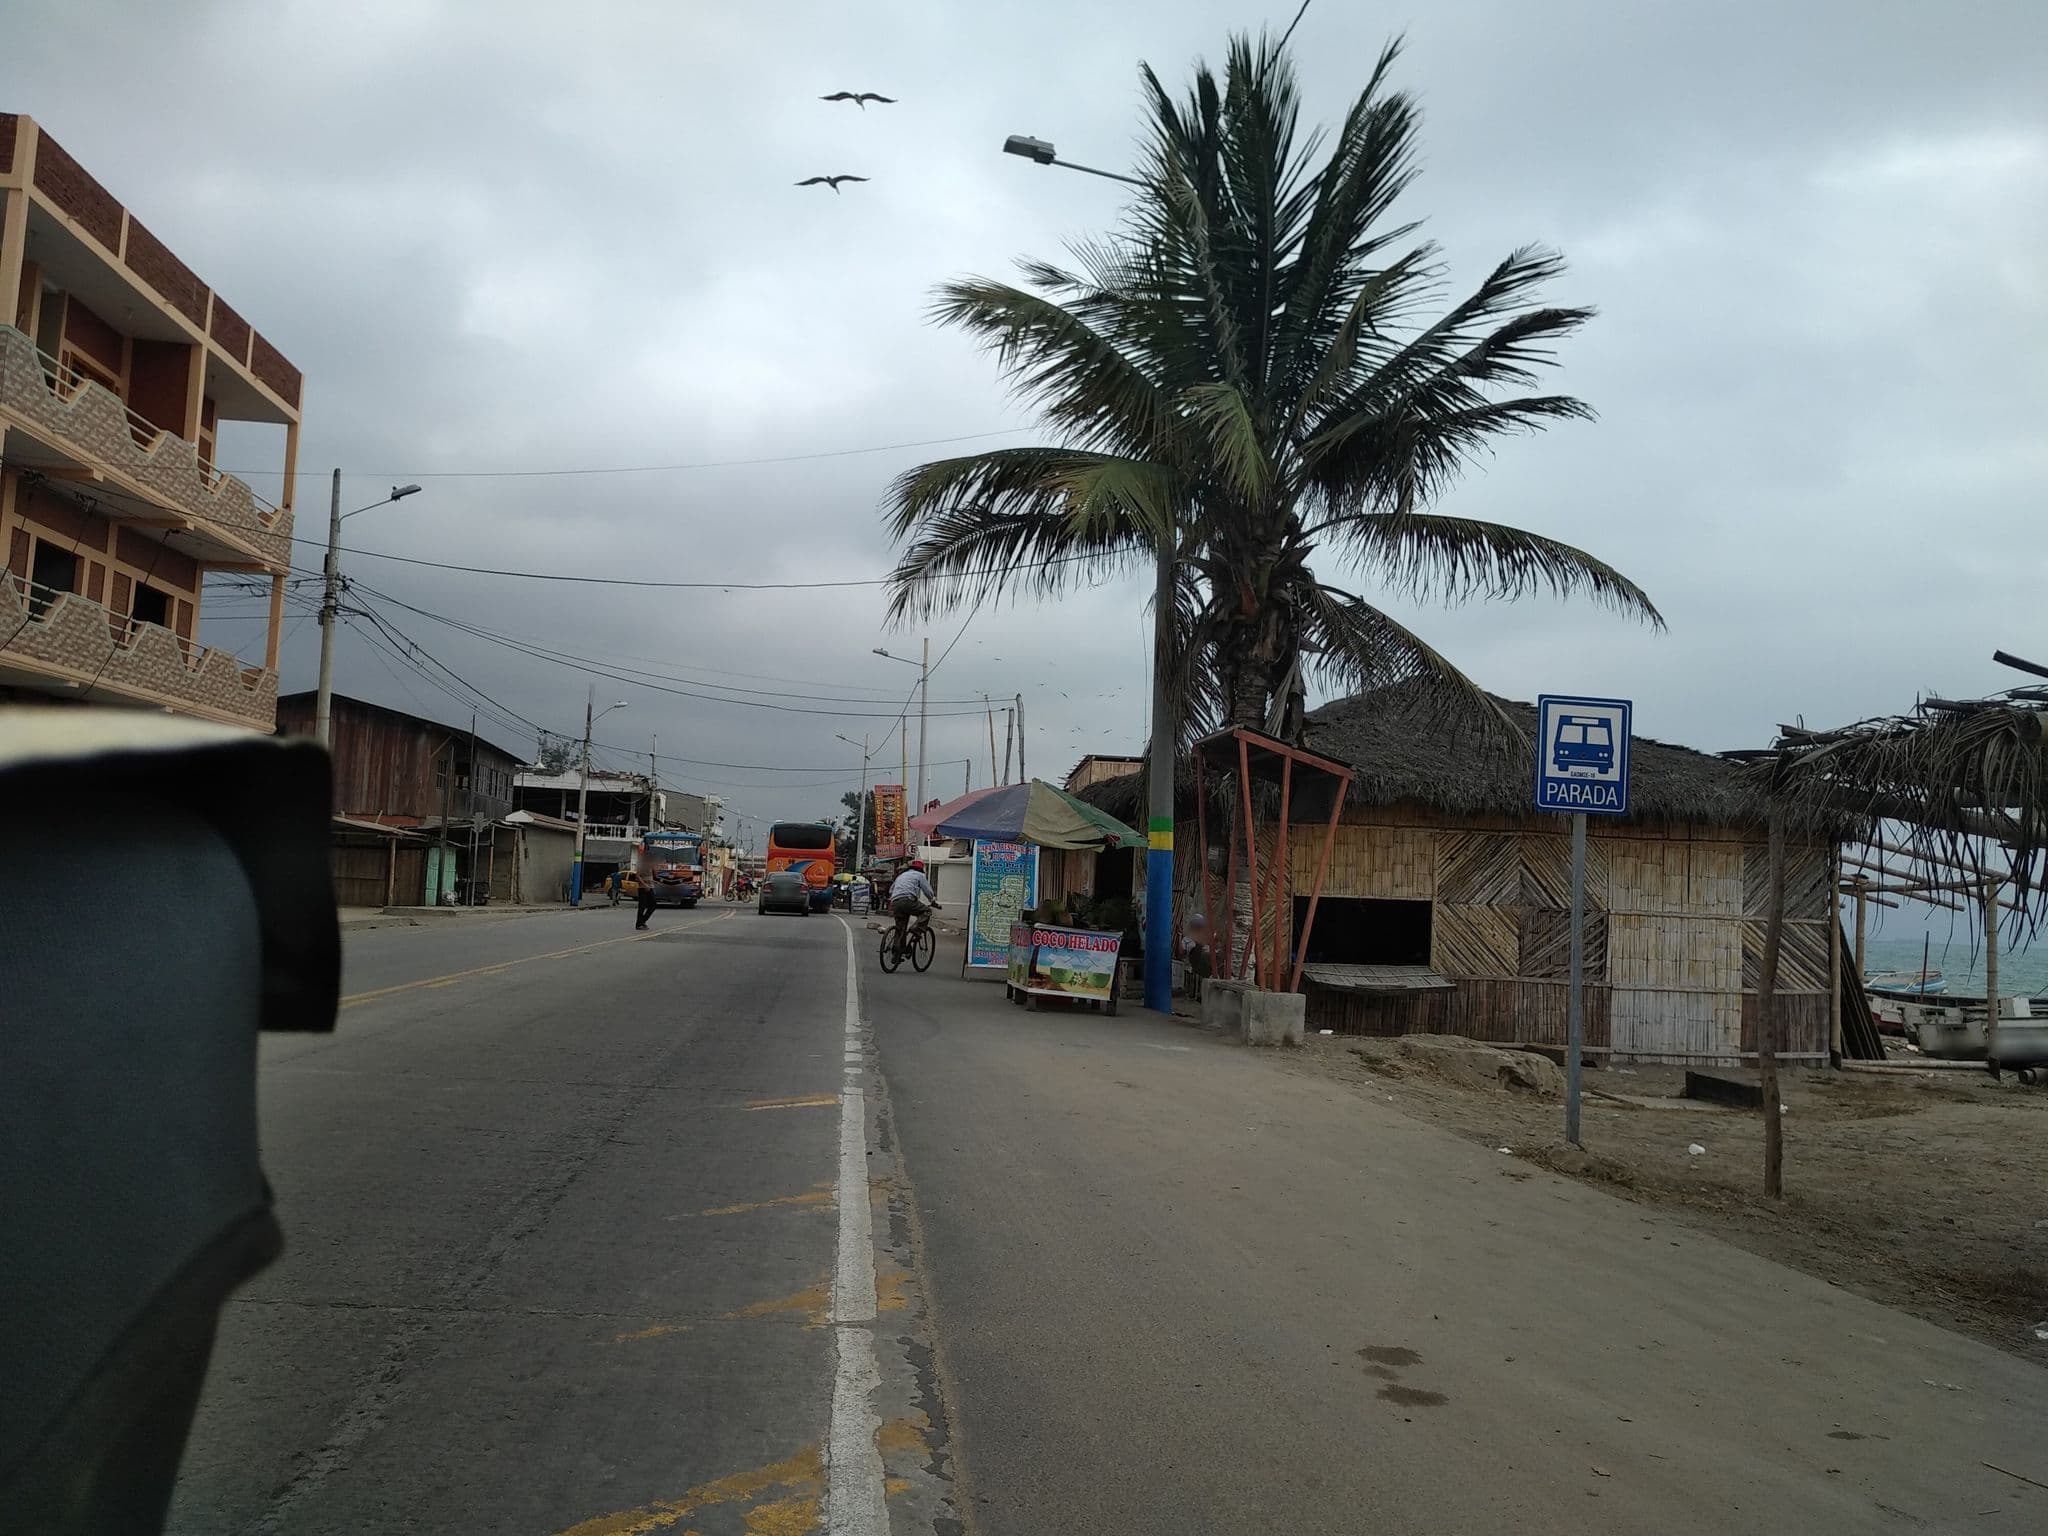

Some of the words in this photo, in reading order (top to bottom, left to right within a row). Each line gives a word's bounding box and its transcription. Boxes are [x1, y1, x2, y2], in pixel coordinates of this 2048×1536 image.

[1546, 782, 1618, 806] PARADA
[1032, 930, 1067, 949] COCO
[1068, 935, 1119, 953] HELADO
